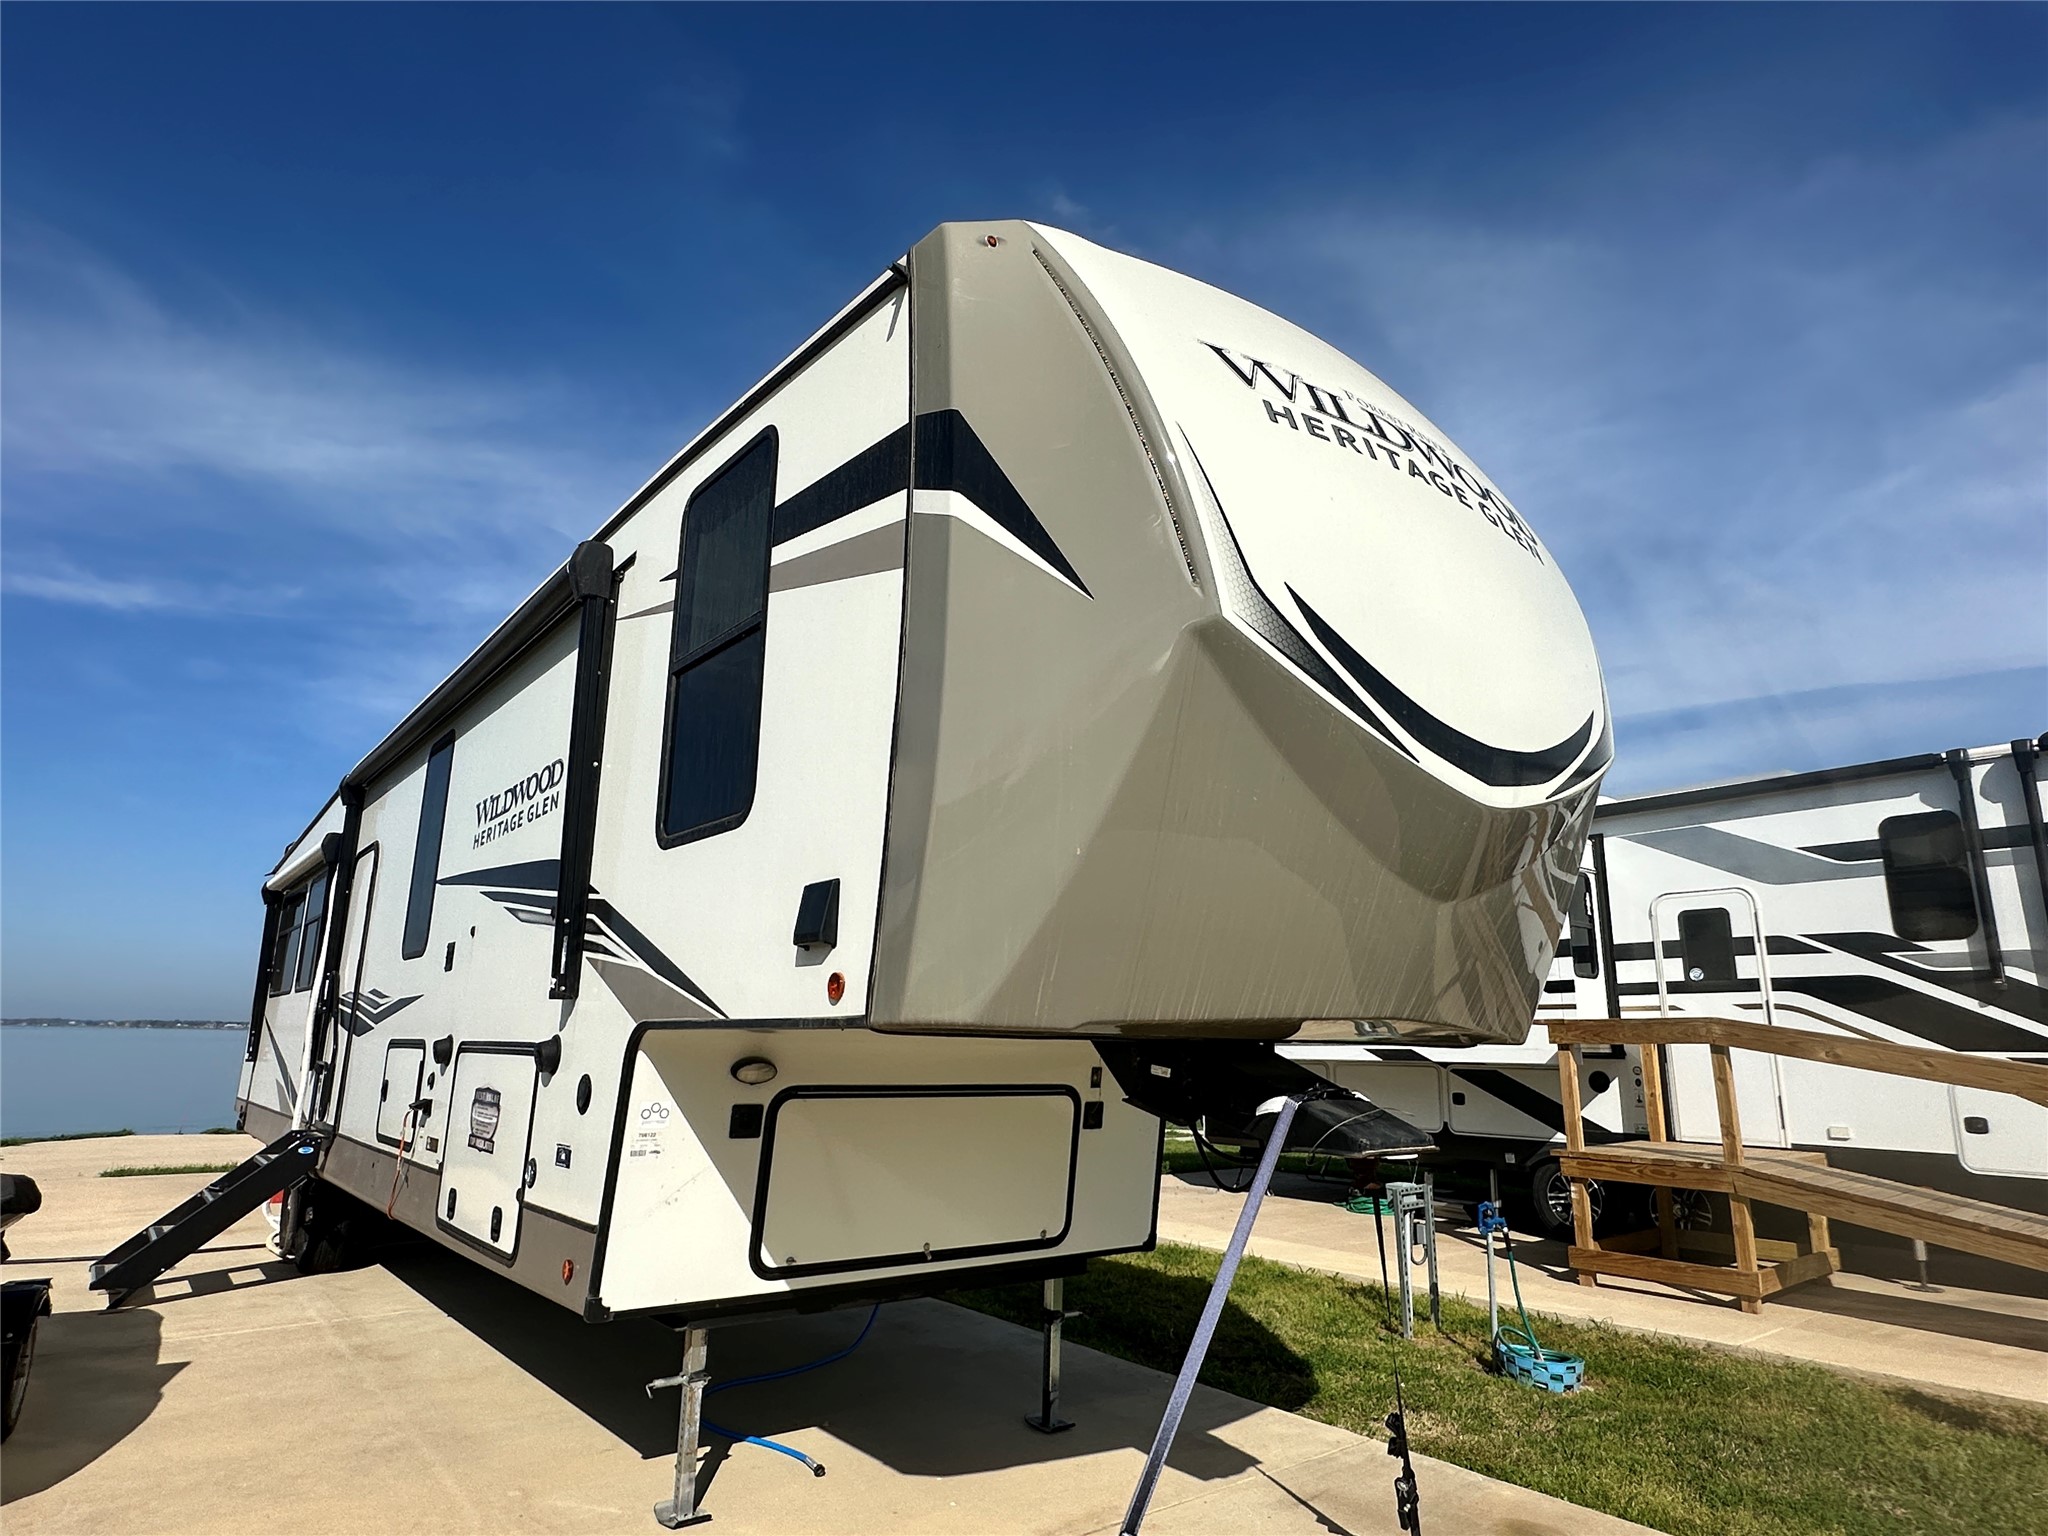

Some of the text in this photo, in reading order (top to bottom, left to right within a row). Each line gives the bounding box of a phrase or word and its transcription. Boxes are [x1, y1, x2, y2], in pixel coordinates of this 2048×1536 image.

[1197, 338, 1538, 546] WILDWOOD
[1262, 399, 1545, 566] HERITAGE GLEN
[473, 791, 560, 849] HERITAGE GLEN
[476, 758, 564, 828] WILDWOOD
